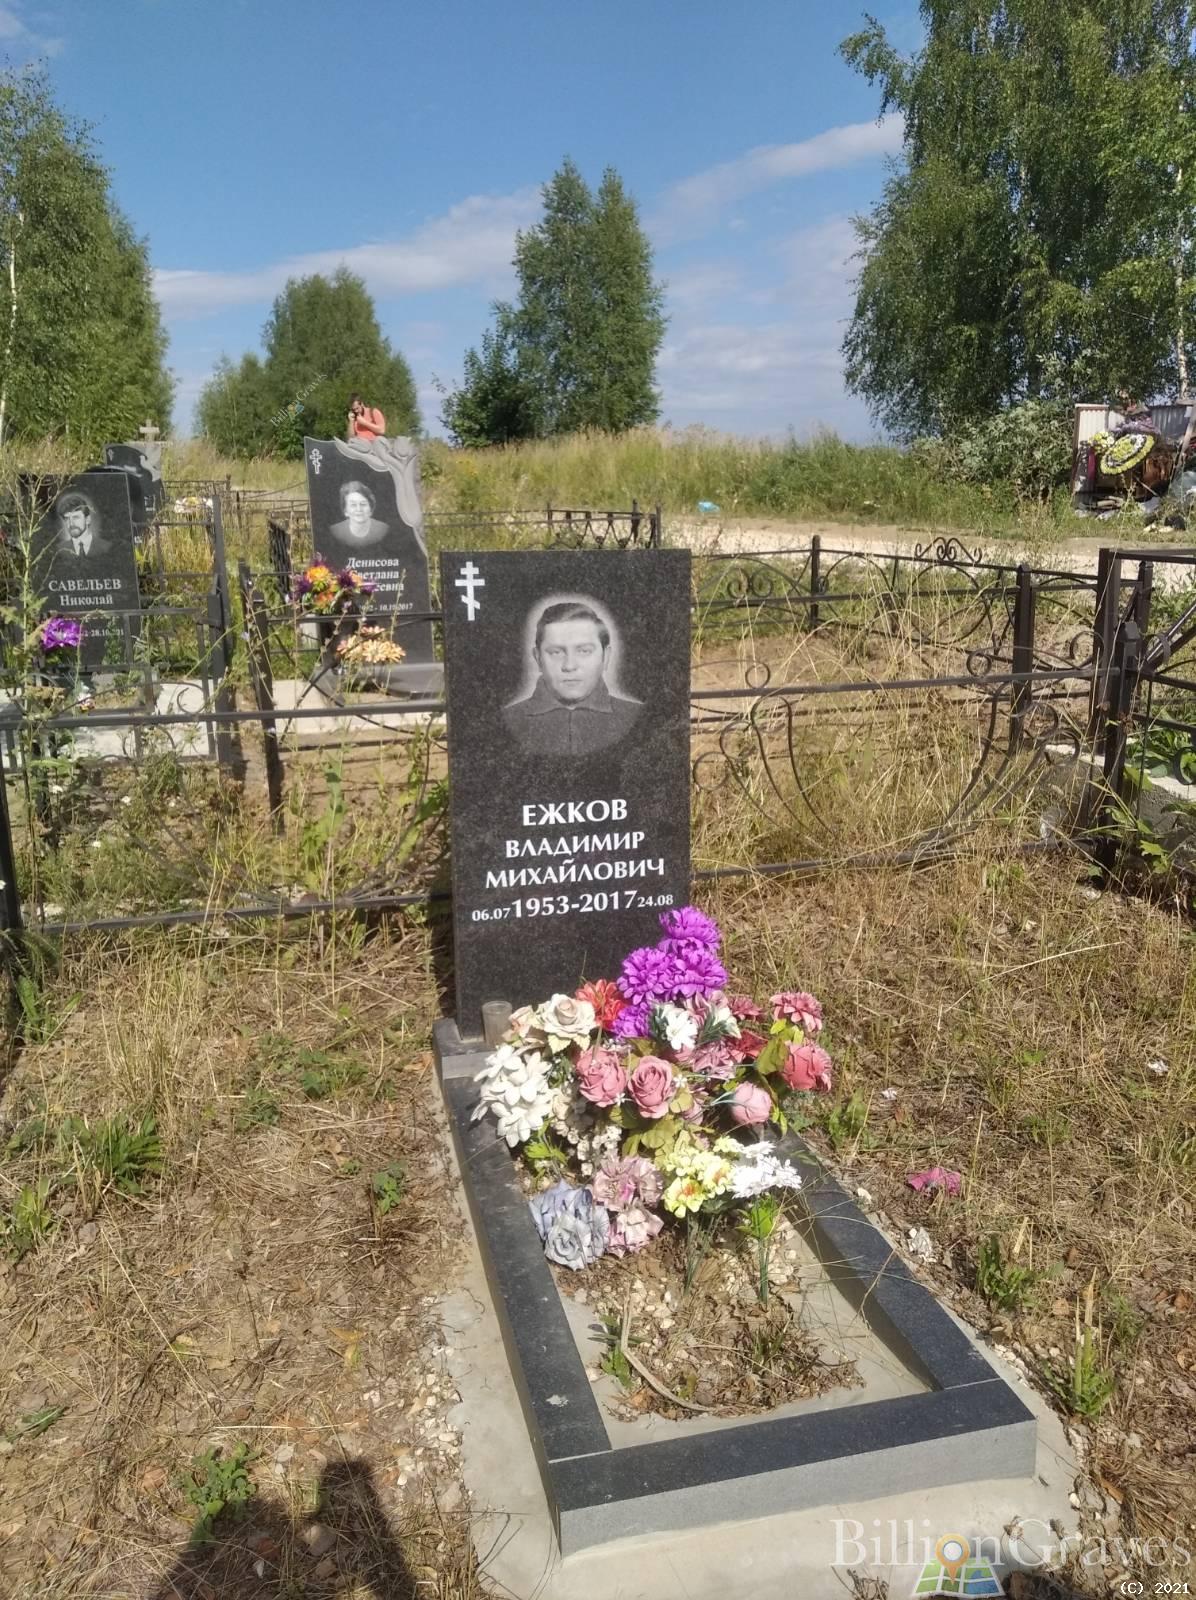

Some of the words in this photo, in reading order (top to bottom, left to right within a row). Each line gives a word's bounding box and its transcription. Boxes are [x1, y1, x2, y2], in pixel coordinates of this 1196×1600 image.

[346, 557, 399, 569] Денисова
[48, 578, 122, 592] САВЕЛЬЕВ
[60, 594, 113, 606] Николай
[522, 799, 628, 826] ЕЖКОВ
[505, 831, 646, 858] ВЛАДИМИР
[485, 858, 665, 889] МИХАЙЛОВИЧ
[471, 907, 511, 921] 06.07
[511, 890, 638, 918] 1953-2017
[637, 894, 674, 908] 24.08
